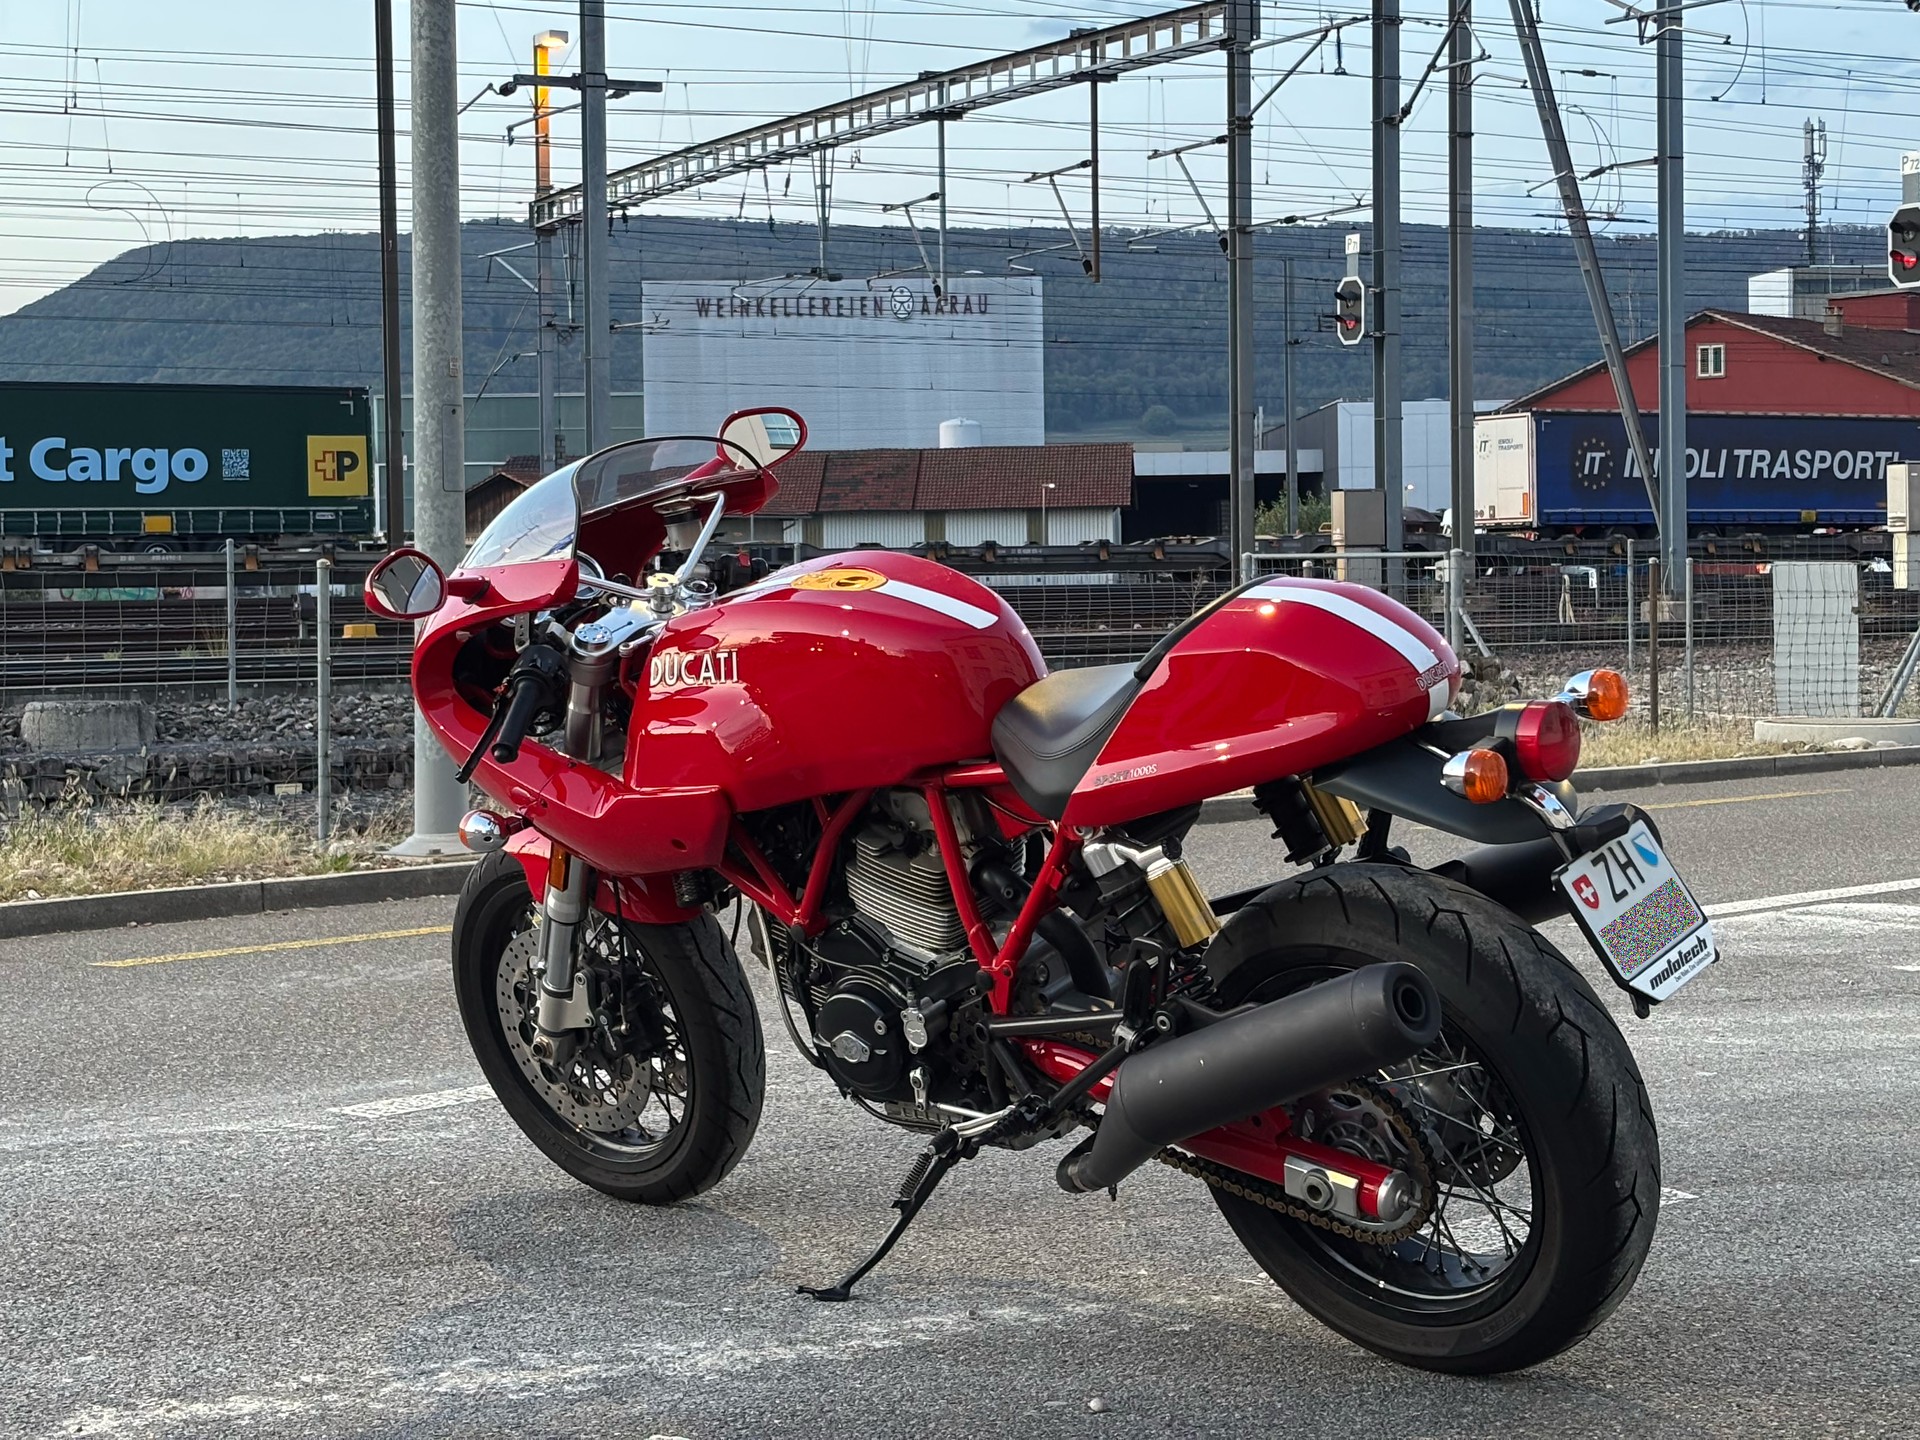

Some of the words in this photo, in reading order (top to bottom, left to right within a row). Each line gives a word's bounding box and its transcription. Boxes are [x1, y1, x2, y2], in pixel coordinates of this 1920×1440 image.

[696, 296, 883, 318] WEINKELLEREIEN
[921, 295, 989, 315] AARAU
[29, 437, 209, 494] Cargo
[1583, 451, 1606, 475] IT
[1623, 448, 1728, 478] IOLI
[650, 651, 739, 687] DUCATI
[1415, 660, 1452, 692] DUCATI
[1591, 840, 1645, 903] ZH
[1649, 935, 1708, 990] mototech
